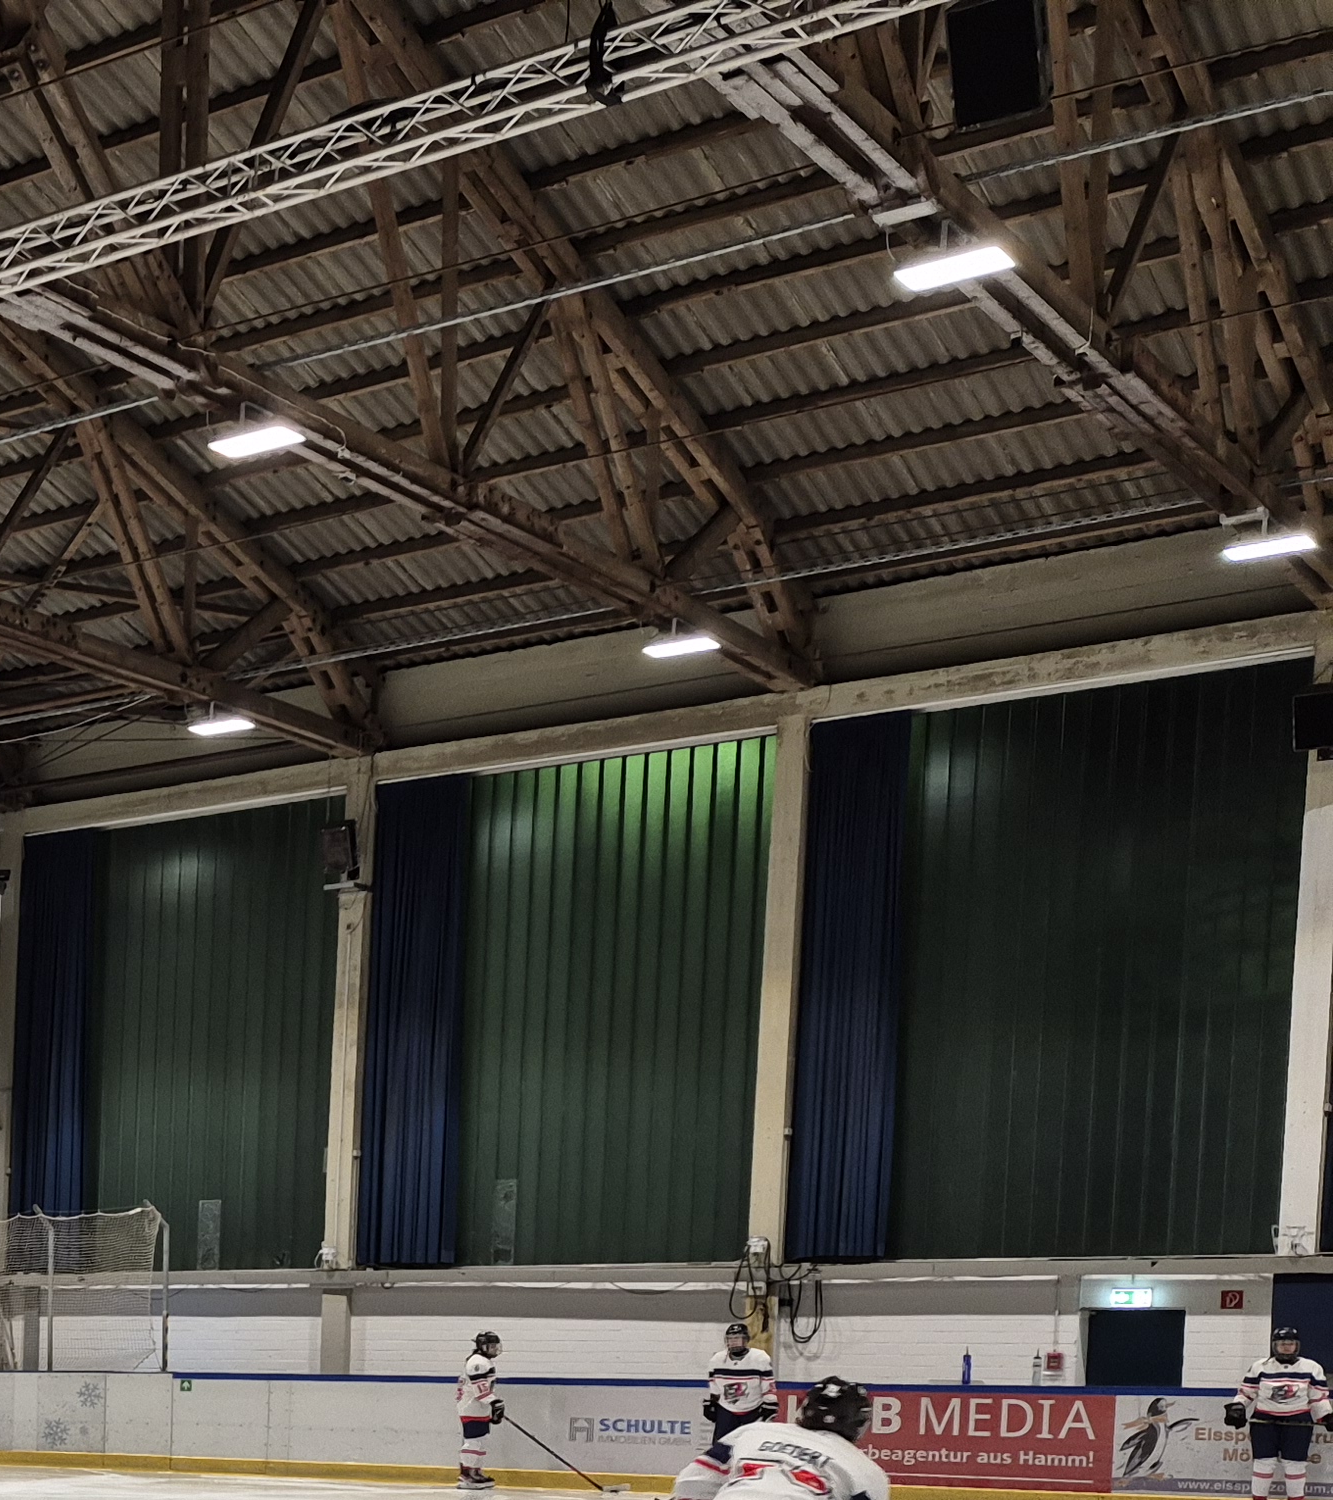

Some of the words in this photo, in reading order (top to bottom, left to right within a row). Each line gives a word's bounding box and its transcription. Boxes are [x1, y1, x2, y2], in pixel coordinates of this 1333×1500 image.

[599, 1418, 692, 1435] SCHULTE
[918, 1397, 1097, 1440] MEDIA
[976, 1451, 1011, 1465] aus
[1019, 1450, 1094, 1468] Hamm!
